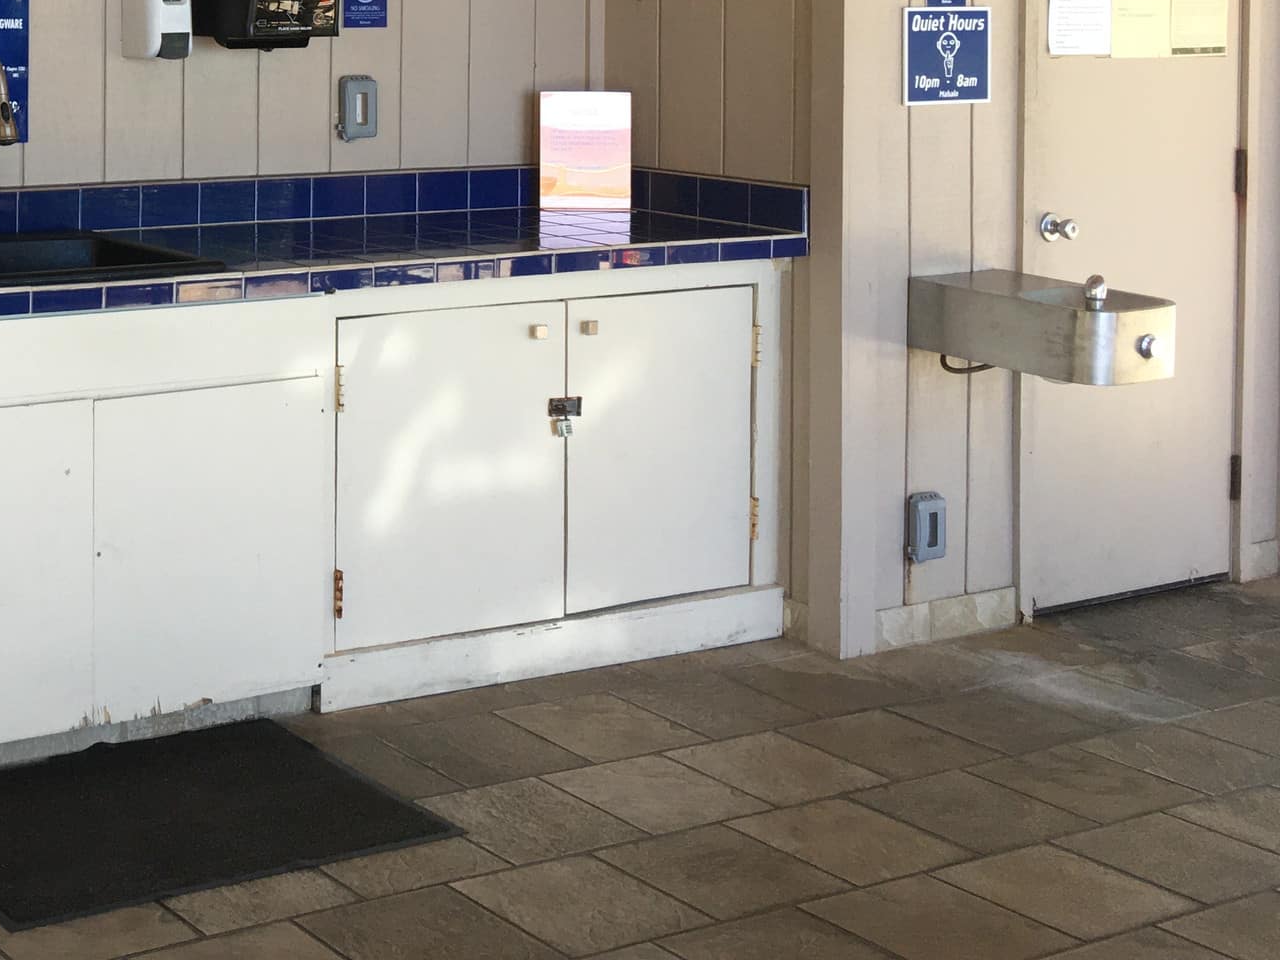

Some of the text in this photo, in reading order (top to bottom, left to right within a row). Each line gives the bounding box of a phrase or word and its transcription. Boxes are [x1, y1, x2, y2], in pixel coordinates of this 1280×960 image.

[911, 13, 985, 32] Quiet Hours
[914, 75, 940, 92] 10pm
[956, 74, 978, 87] 8am
